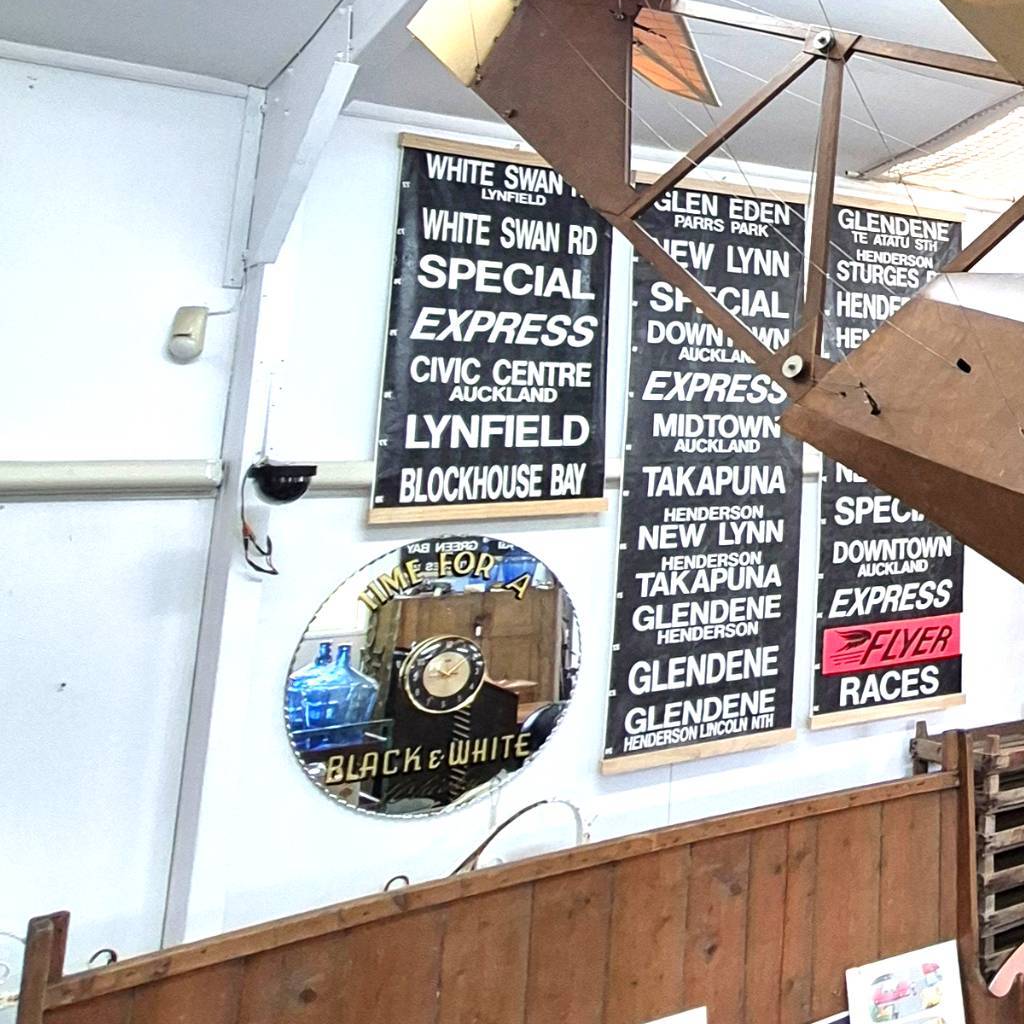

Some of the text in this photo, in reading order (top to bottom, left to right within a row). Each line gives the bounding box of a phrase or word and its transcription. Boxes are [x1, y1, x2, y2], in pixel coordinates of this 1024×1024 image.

[426, 153, 495, 187] WHITE
[504, 164, 563, 196] SWAN
[481, 188, 547, 206] LYNFIELD
[653, 190, 790, 225] GLEN EDEN
[422, 207, 598, 256] WHITE SWAN RD
[674, 214, 770, 238] PARRS PARK
[837, 208, 950, 242] GLENDENE
[851, 230, 938, 253] TE ATATU STH
[727, 245, 790, 278] LYNN
[836, 259, 920, 288] STURGES
[856, 249, 934, 269] HENDERSON
[417, 253, 596, 301] SPECIAL
[650, 281, 790, 319] SCIAL
[409, 306, 599, 348] EXPRESS
[646, 320, 790, 350] DOWNWN
[410, 355, 592, 388] CIVIC CENTRE
[678, 346, 757, 364] AUCKLAN
[448, 386, 558, 403] AUCKLAND
[642, 370, 788, 404] EXPRESS
[405, 414, 590, 449] LYNFIELD
[652, 413, 781, 439] MIDTOWN
[674, 439, 761, 453] AUCKLAND
[399, 462, 587, 504] BLOCKHOUSE BAY
[642, 465, 787, 497] TAKAPUNA
[663, 505, 764, 523] HENDERSON
[637, 519, 785, 551] NEW LYNN
[832, 535, 952, 564] DOWNTOWN
[661, 551, 763, 571] HENDERSON
[857, 559, 929, 578] AUCKLAND
[359, 559, 423, 611] TIME
[438, 551, 496, 580] FOR
[505, 574, 531, 600] A
[635, 564, 782, 598] TAKAPUNA
[632, 594, 782, 632] GLENDENE
[828, 579, 953, 619] EXPRESS
[656, 621, 759, 645] HENDERSON
[860, 624, 953, 665] FLYER
[628, 645, 780, 696] GLENDENE
[839, 665, 940, 707] RACES
[624, 688, 776, 736] GLENDENE
[623, 714, 774, 752] HENDERSON LINCOLN NTH
[324, 732, 532, 785] BLACK & WHITE
